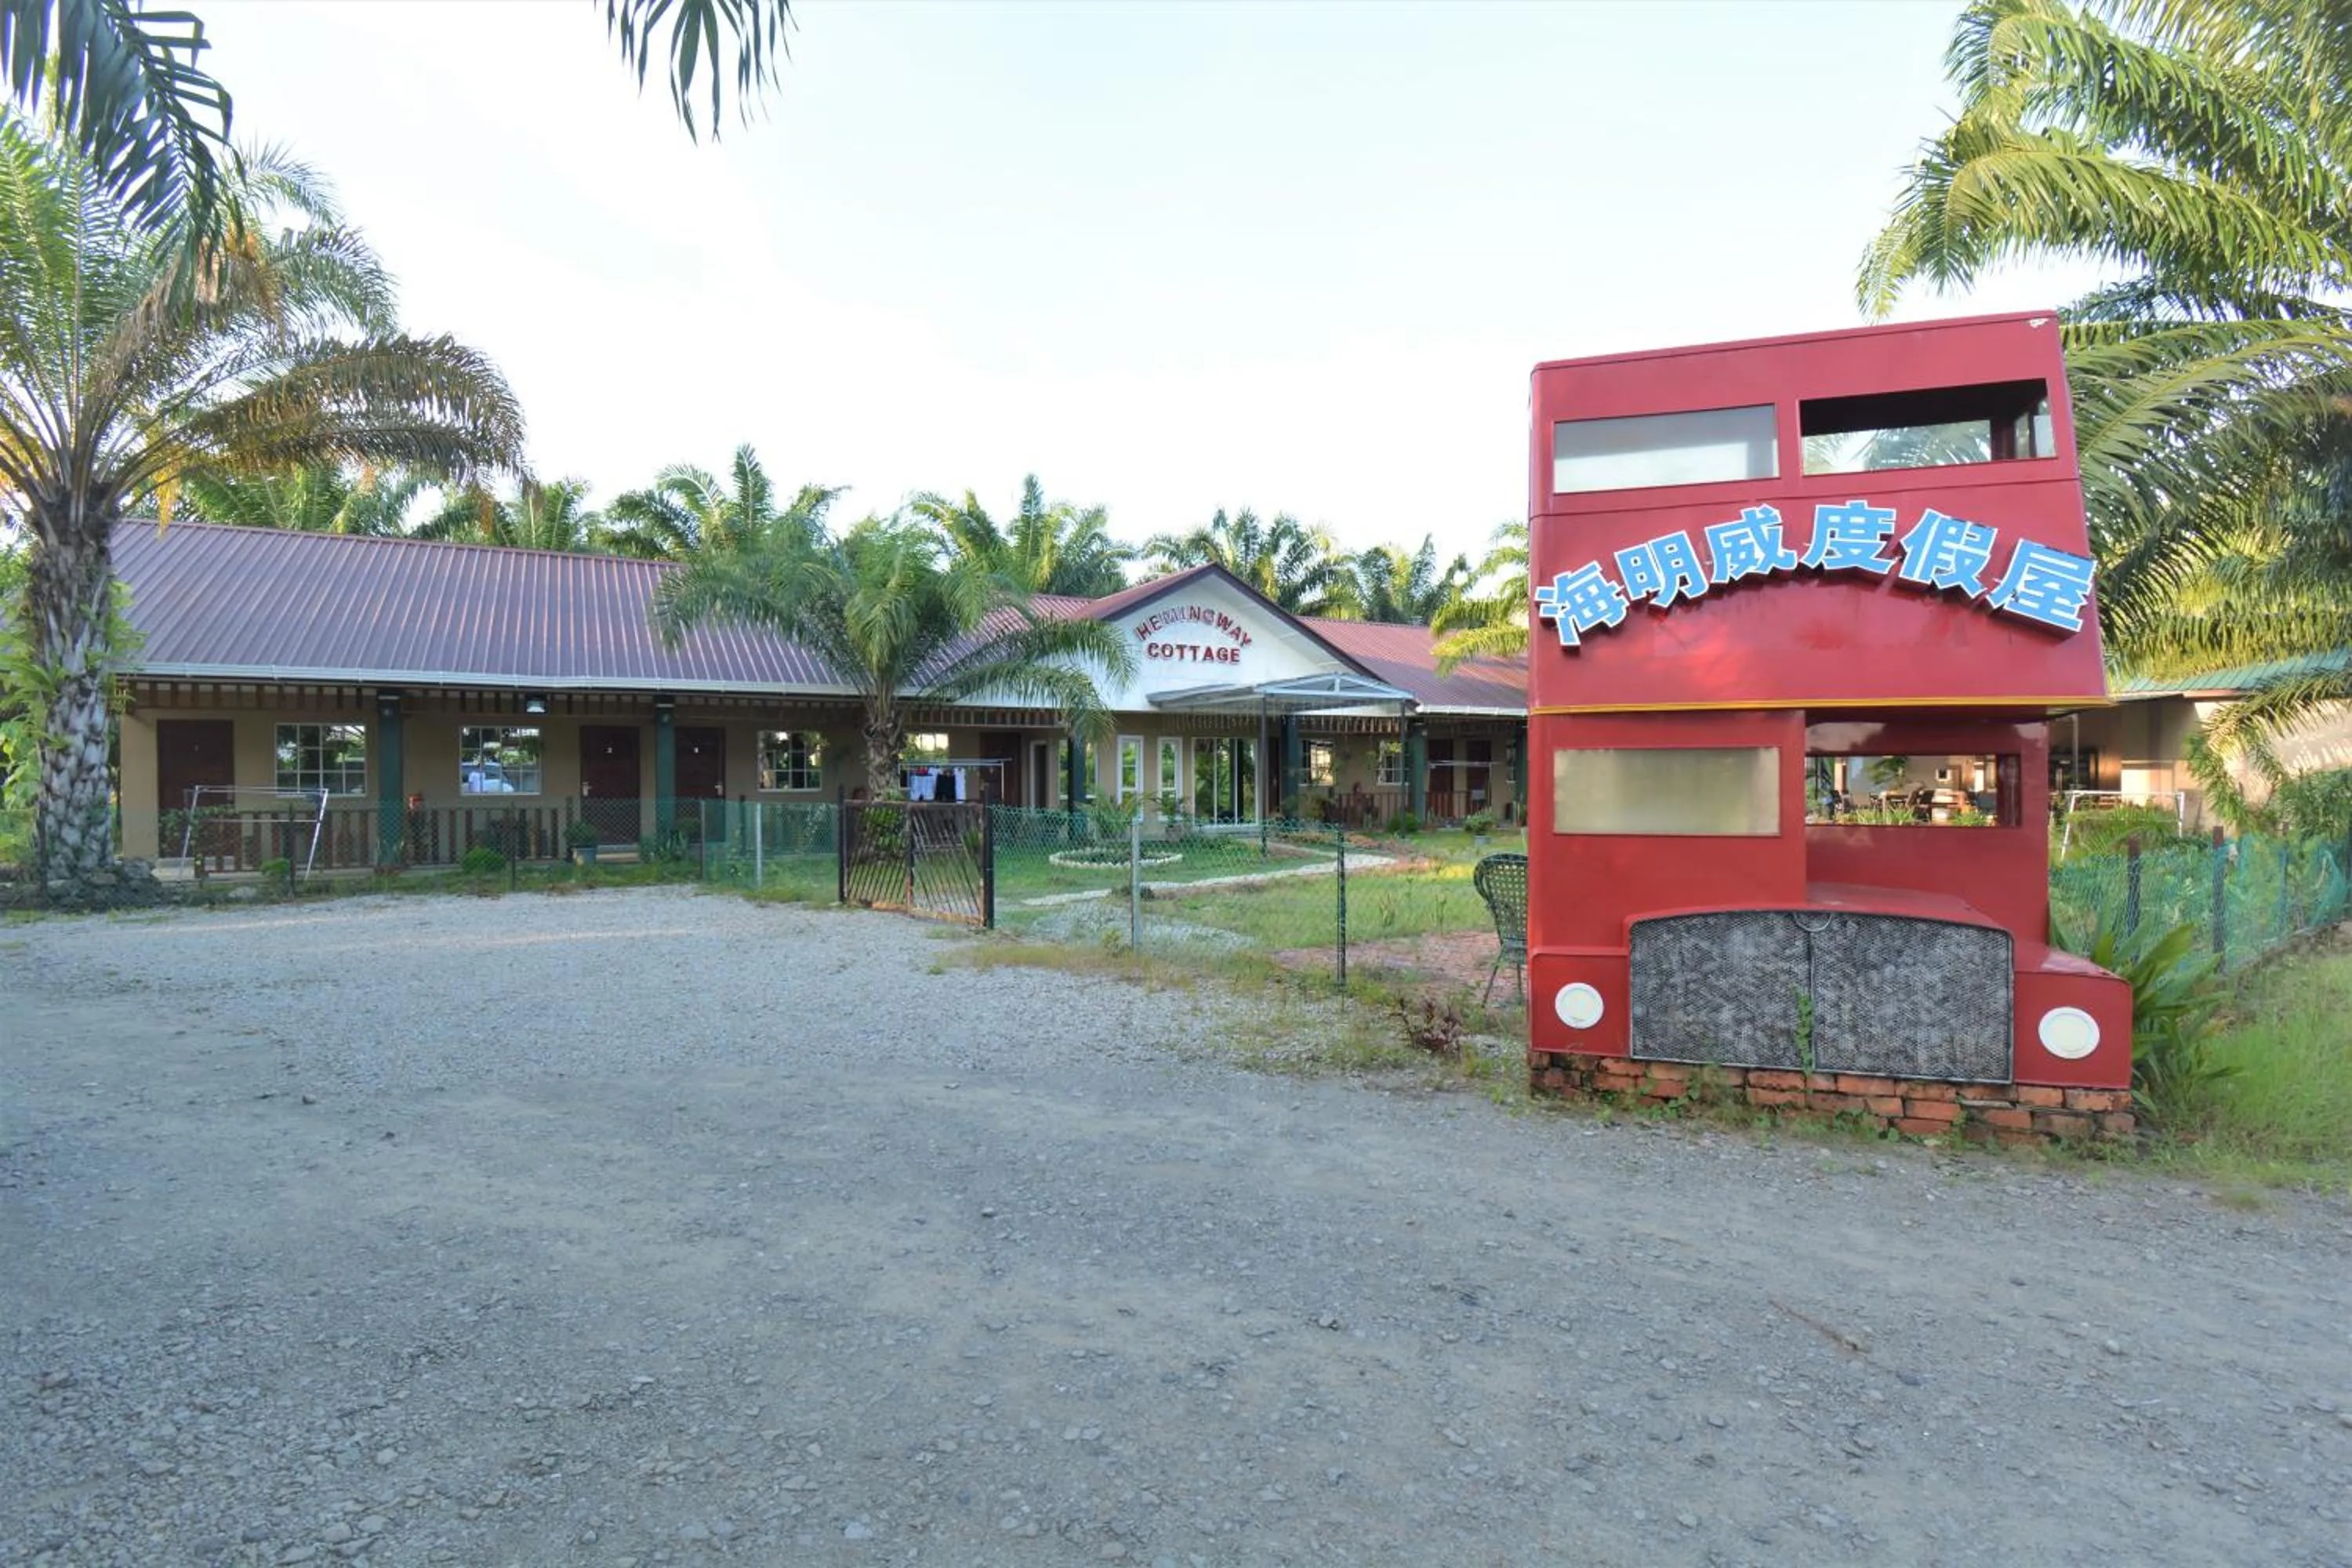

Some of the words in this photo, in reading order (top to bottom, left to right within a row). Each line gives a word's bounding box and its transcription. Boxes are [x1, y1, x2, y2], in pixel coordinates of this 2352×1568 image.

[1534, 499, 2098, 646] 海明威度假屋
[1135, 605, 1252, 647] HEMINGWAY
[1147, 642, 1241, 662] COTTAGE
